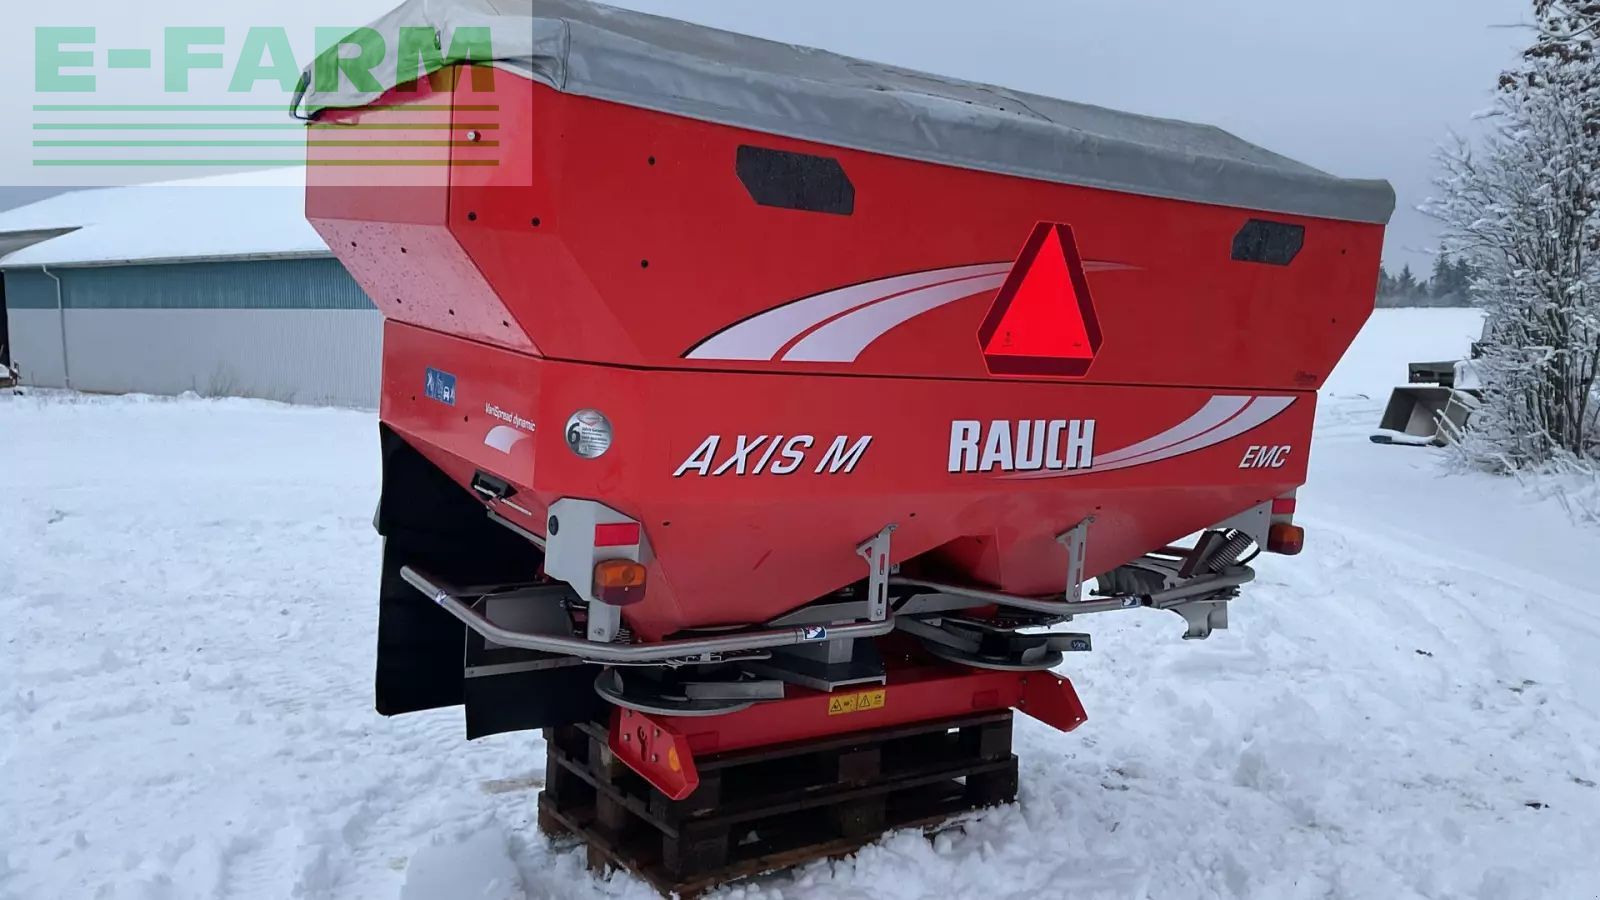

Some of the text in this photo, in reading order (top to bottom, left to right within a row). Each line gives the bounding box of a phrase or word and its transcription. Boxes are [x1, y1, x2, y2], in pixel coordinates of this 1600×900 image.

[485, 402, 536, 432] VariSpread dynamic
[567, 421, 581, 445] 6
[948, 419, 1096, 473] RAUCH
[672, 435, 873, 477] AXIS M
[1238, 445, 1292, 469] EMC
